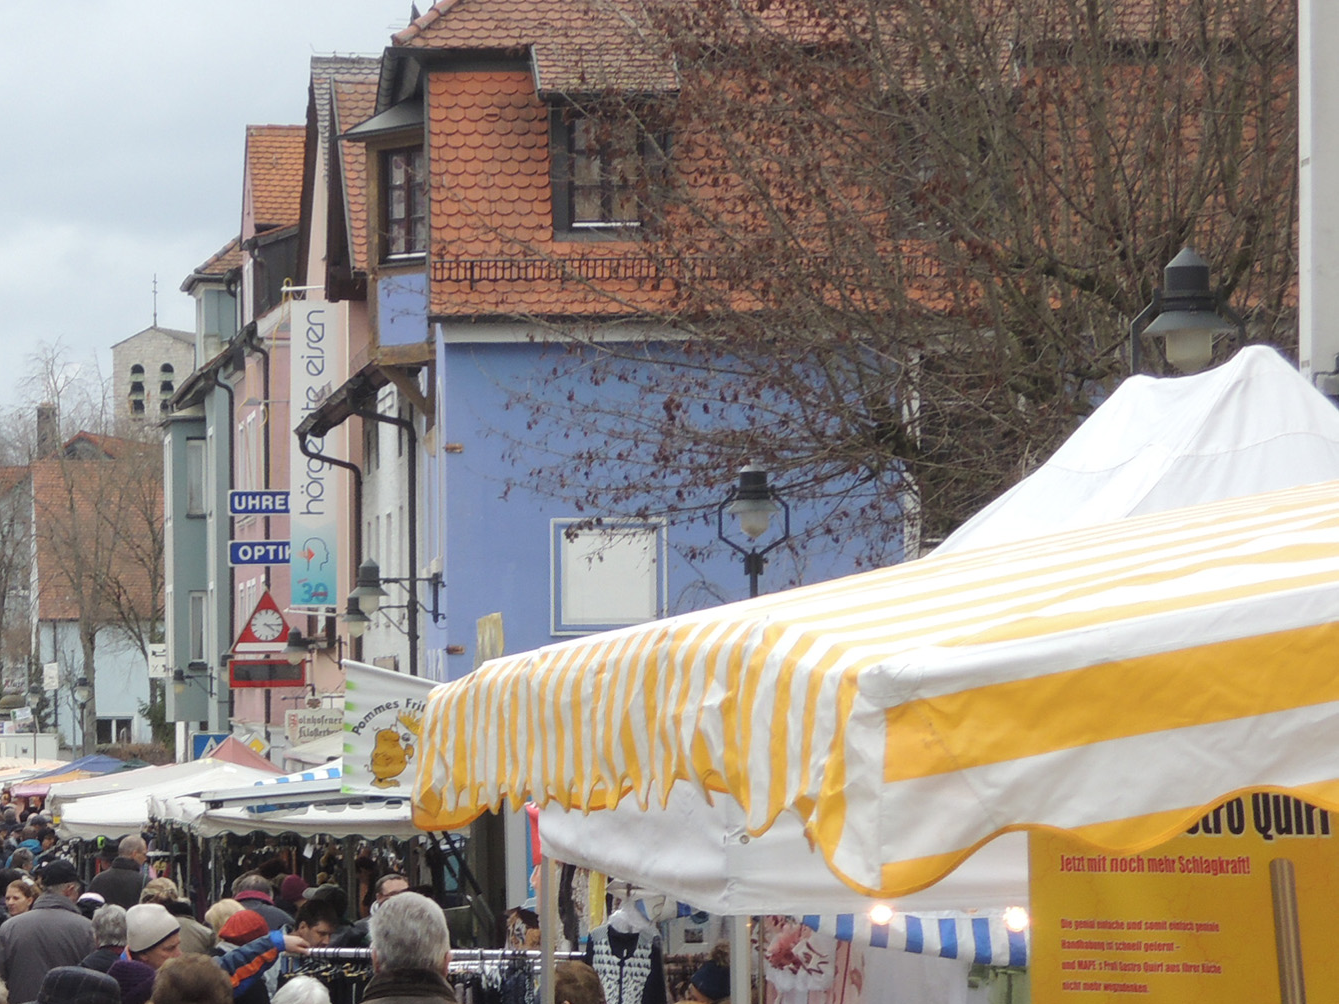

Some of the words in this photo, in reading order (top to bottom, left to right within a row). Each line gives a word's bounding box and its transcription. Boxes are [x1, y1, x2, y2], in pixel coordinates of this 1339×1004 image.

[301, 310, 324, 376] eisen
[234, 494, 290, 510] UHRE
[1252, 792, 1330, 841] Quirl
[1060, 855, 1085, 872] Jetzt
[1087, 855, 1107, 872] mit
[1110, 856, 1144, 873] noch
[1148, 857, 1176, 873] mehr
[1178, 856, 1251, 877] Schlagkraft!
